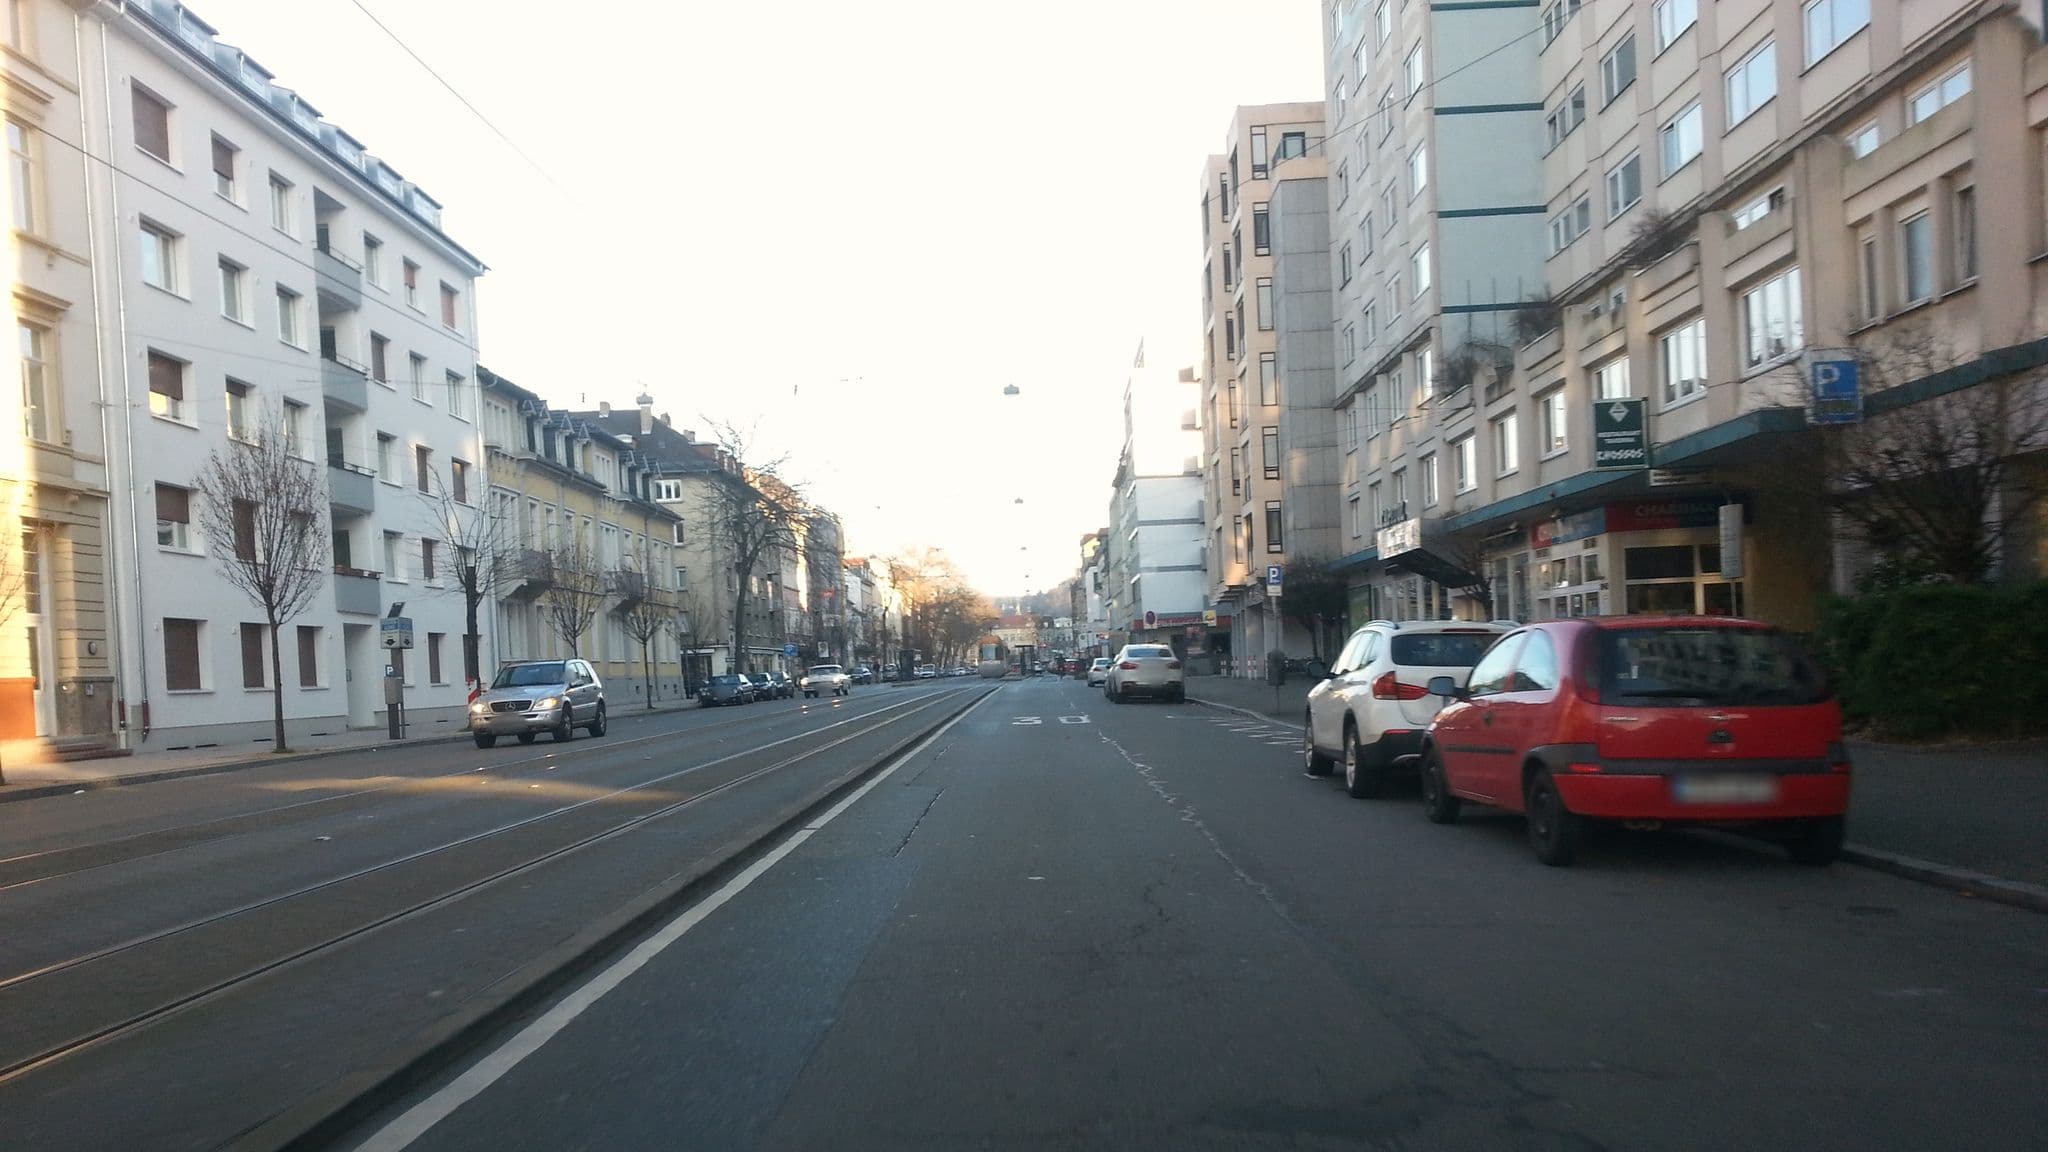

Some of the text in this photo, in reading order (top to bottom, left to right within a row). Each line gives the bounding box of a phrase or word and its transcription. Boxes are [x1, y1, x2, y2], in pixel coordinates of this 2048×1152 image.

[1816, 364, 1840, 397] P
[1270, 568, 1279, 584] P
[386, 666, 394, 676] P
